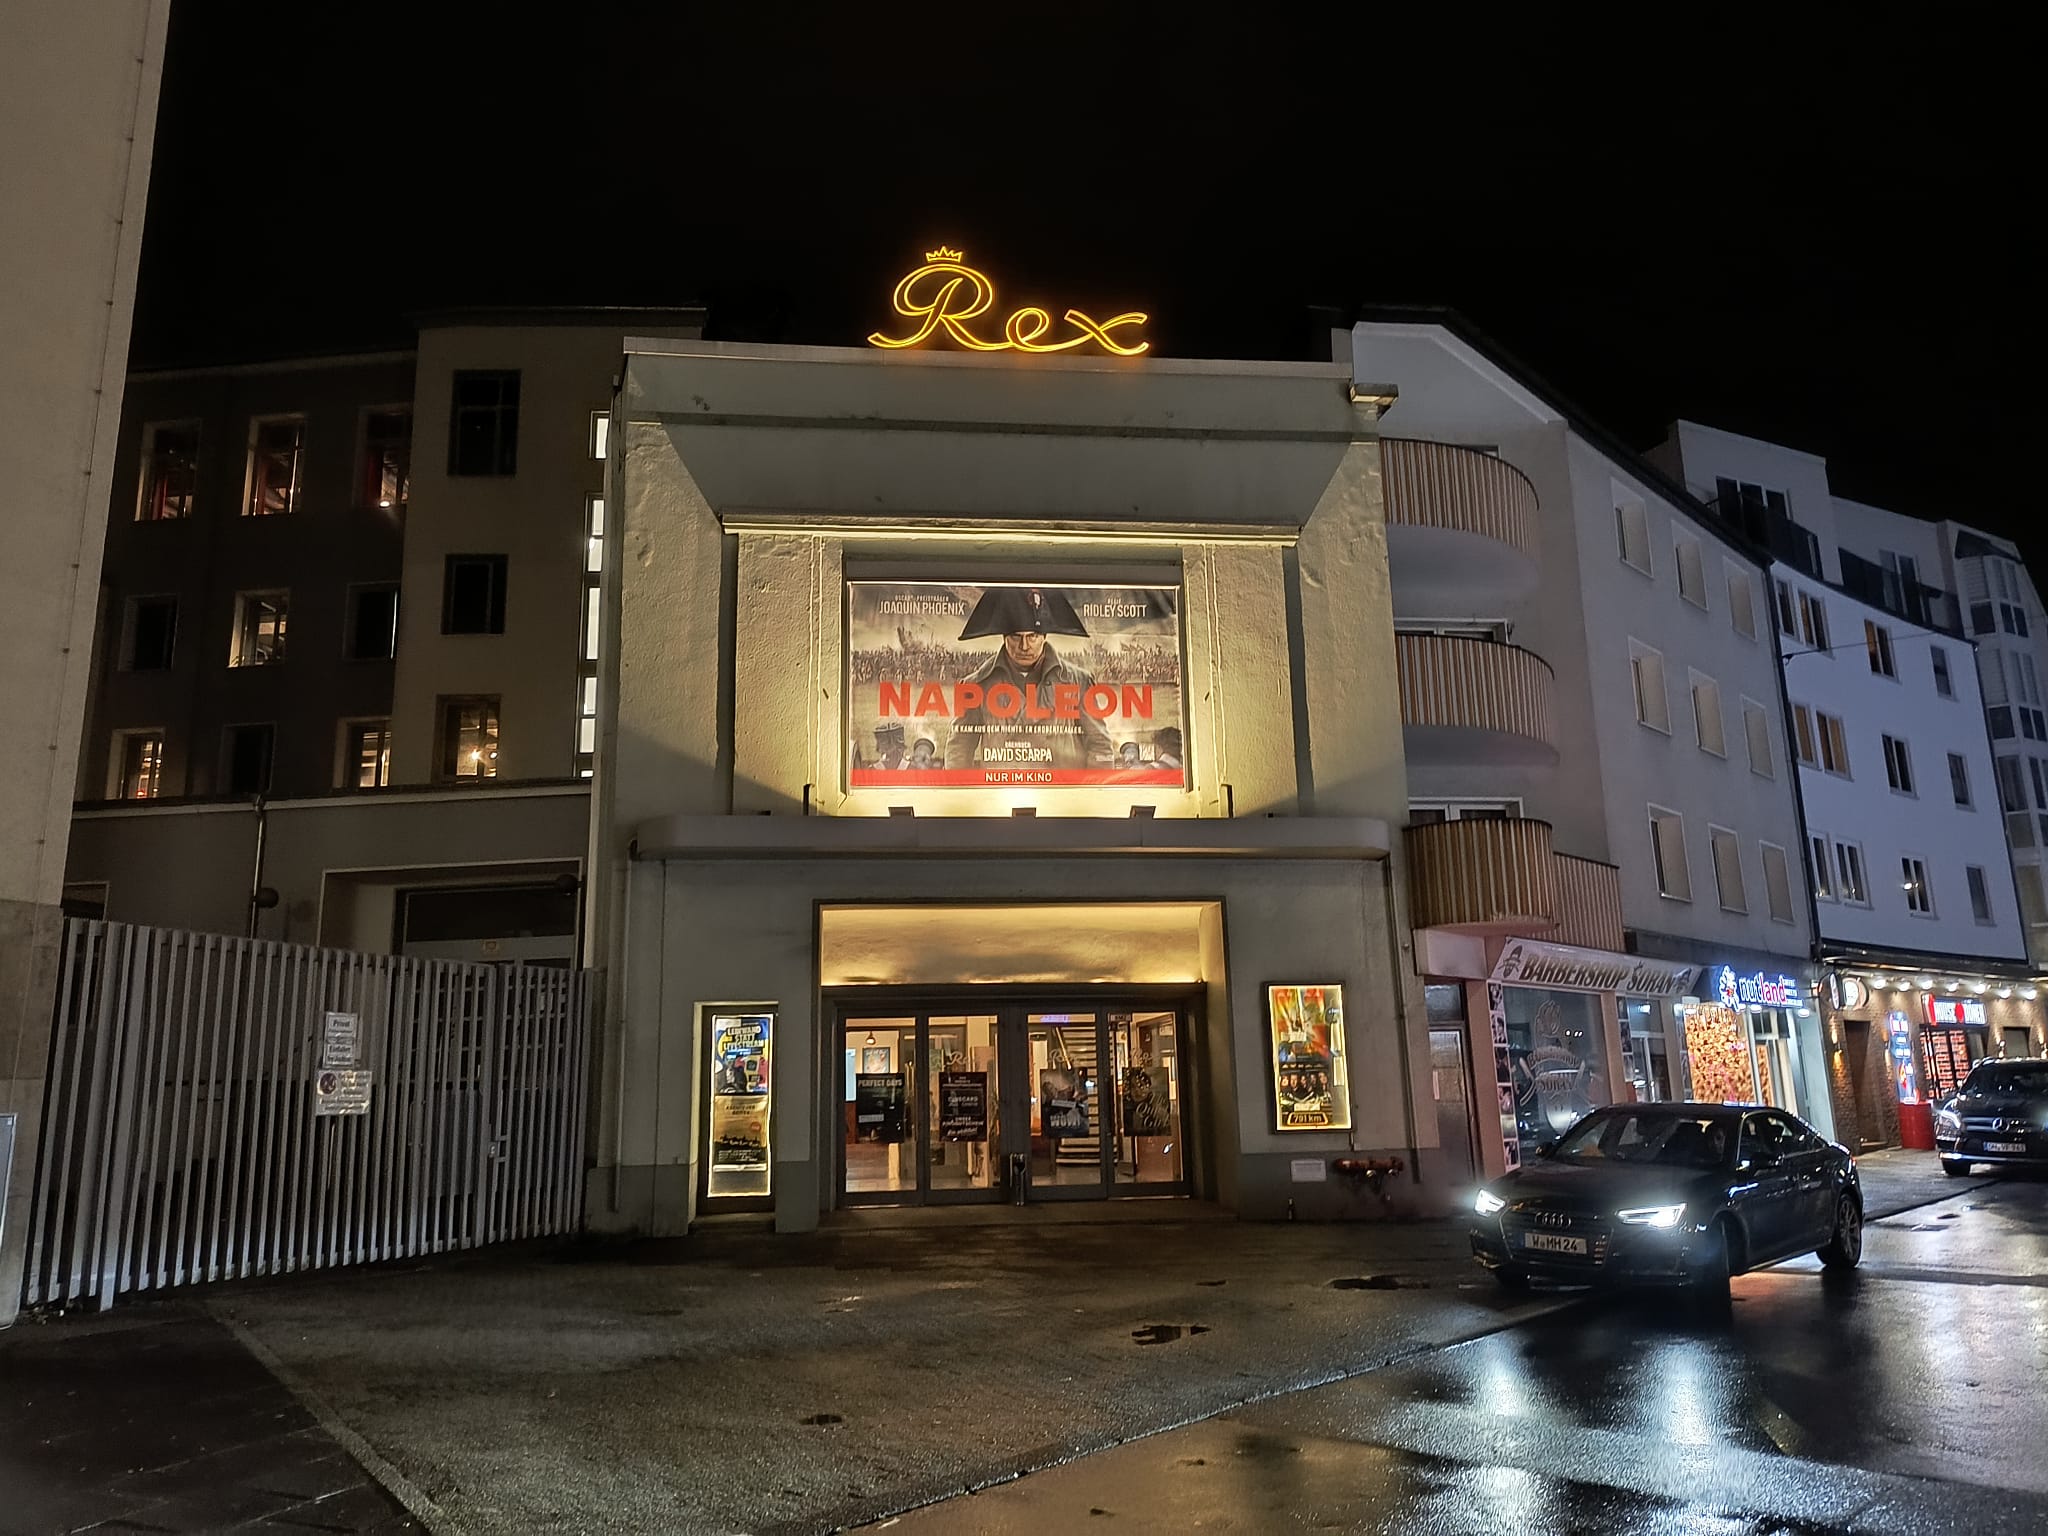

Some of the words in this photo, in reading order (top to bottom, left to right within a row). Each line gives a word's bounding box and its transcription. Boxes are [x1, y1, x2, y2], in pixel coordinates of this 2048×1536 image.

[867, 263, 1149, 355] Rex
[880, 600, 920, 615] JOAQUIN
[922, 602, 965, 615] PHOENIX
[1083, 604, 1116, 617] RIDLEY
[1117, 605, 1147, 617] SCOTT
[879, 681, 1153, 719] NAPOLEON
[983, 748, 1014, 762] DAVID
[1015, 748, 1053, 762] SCARPA
[985, 772, 1009, 782] NUR
[1011, 772, 1024, 782] IM
[1026, 772, 1052, 782] KINO
[1519, 953, 1631, 990] BARBERSHOP
[1738, 972, 1787, 1006] nutland
[858, 1079, 885, 1087] PERFECT
[1308, 1114, 1322, 1122] km
[1532, 1235, 1540, 1248] W
[1546, 1236, 1562, 1249] MH
[1563, 1238, 1578, 1251] 24
